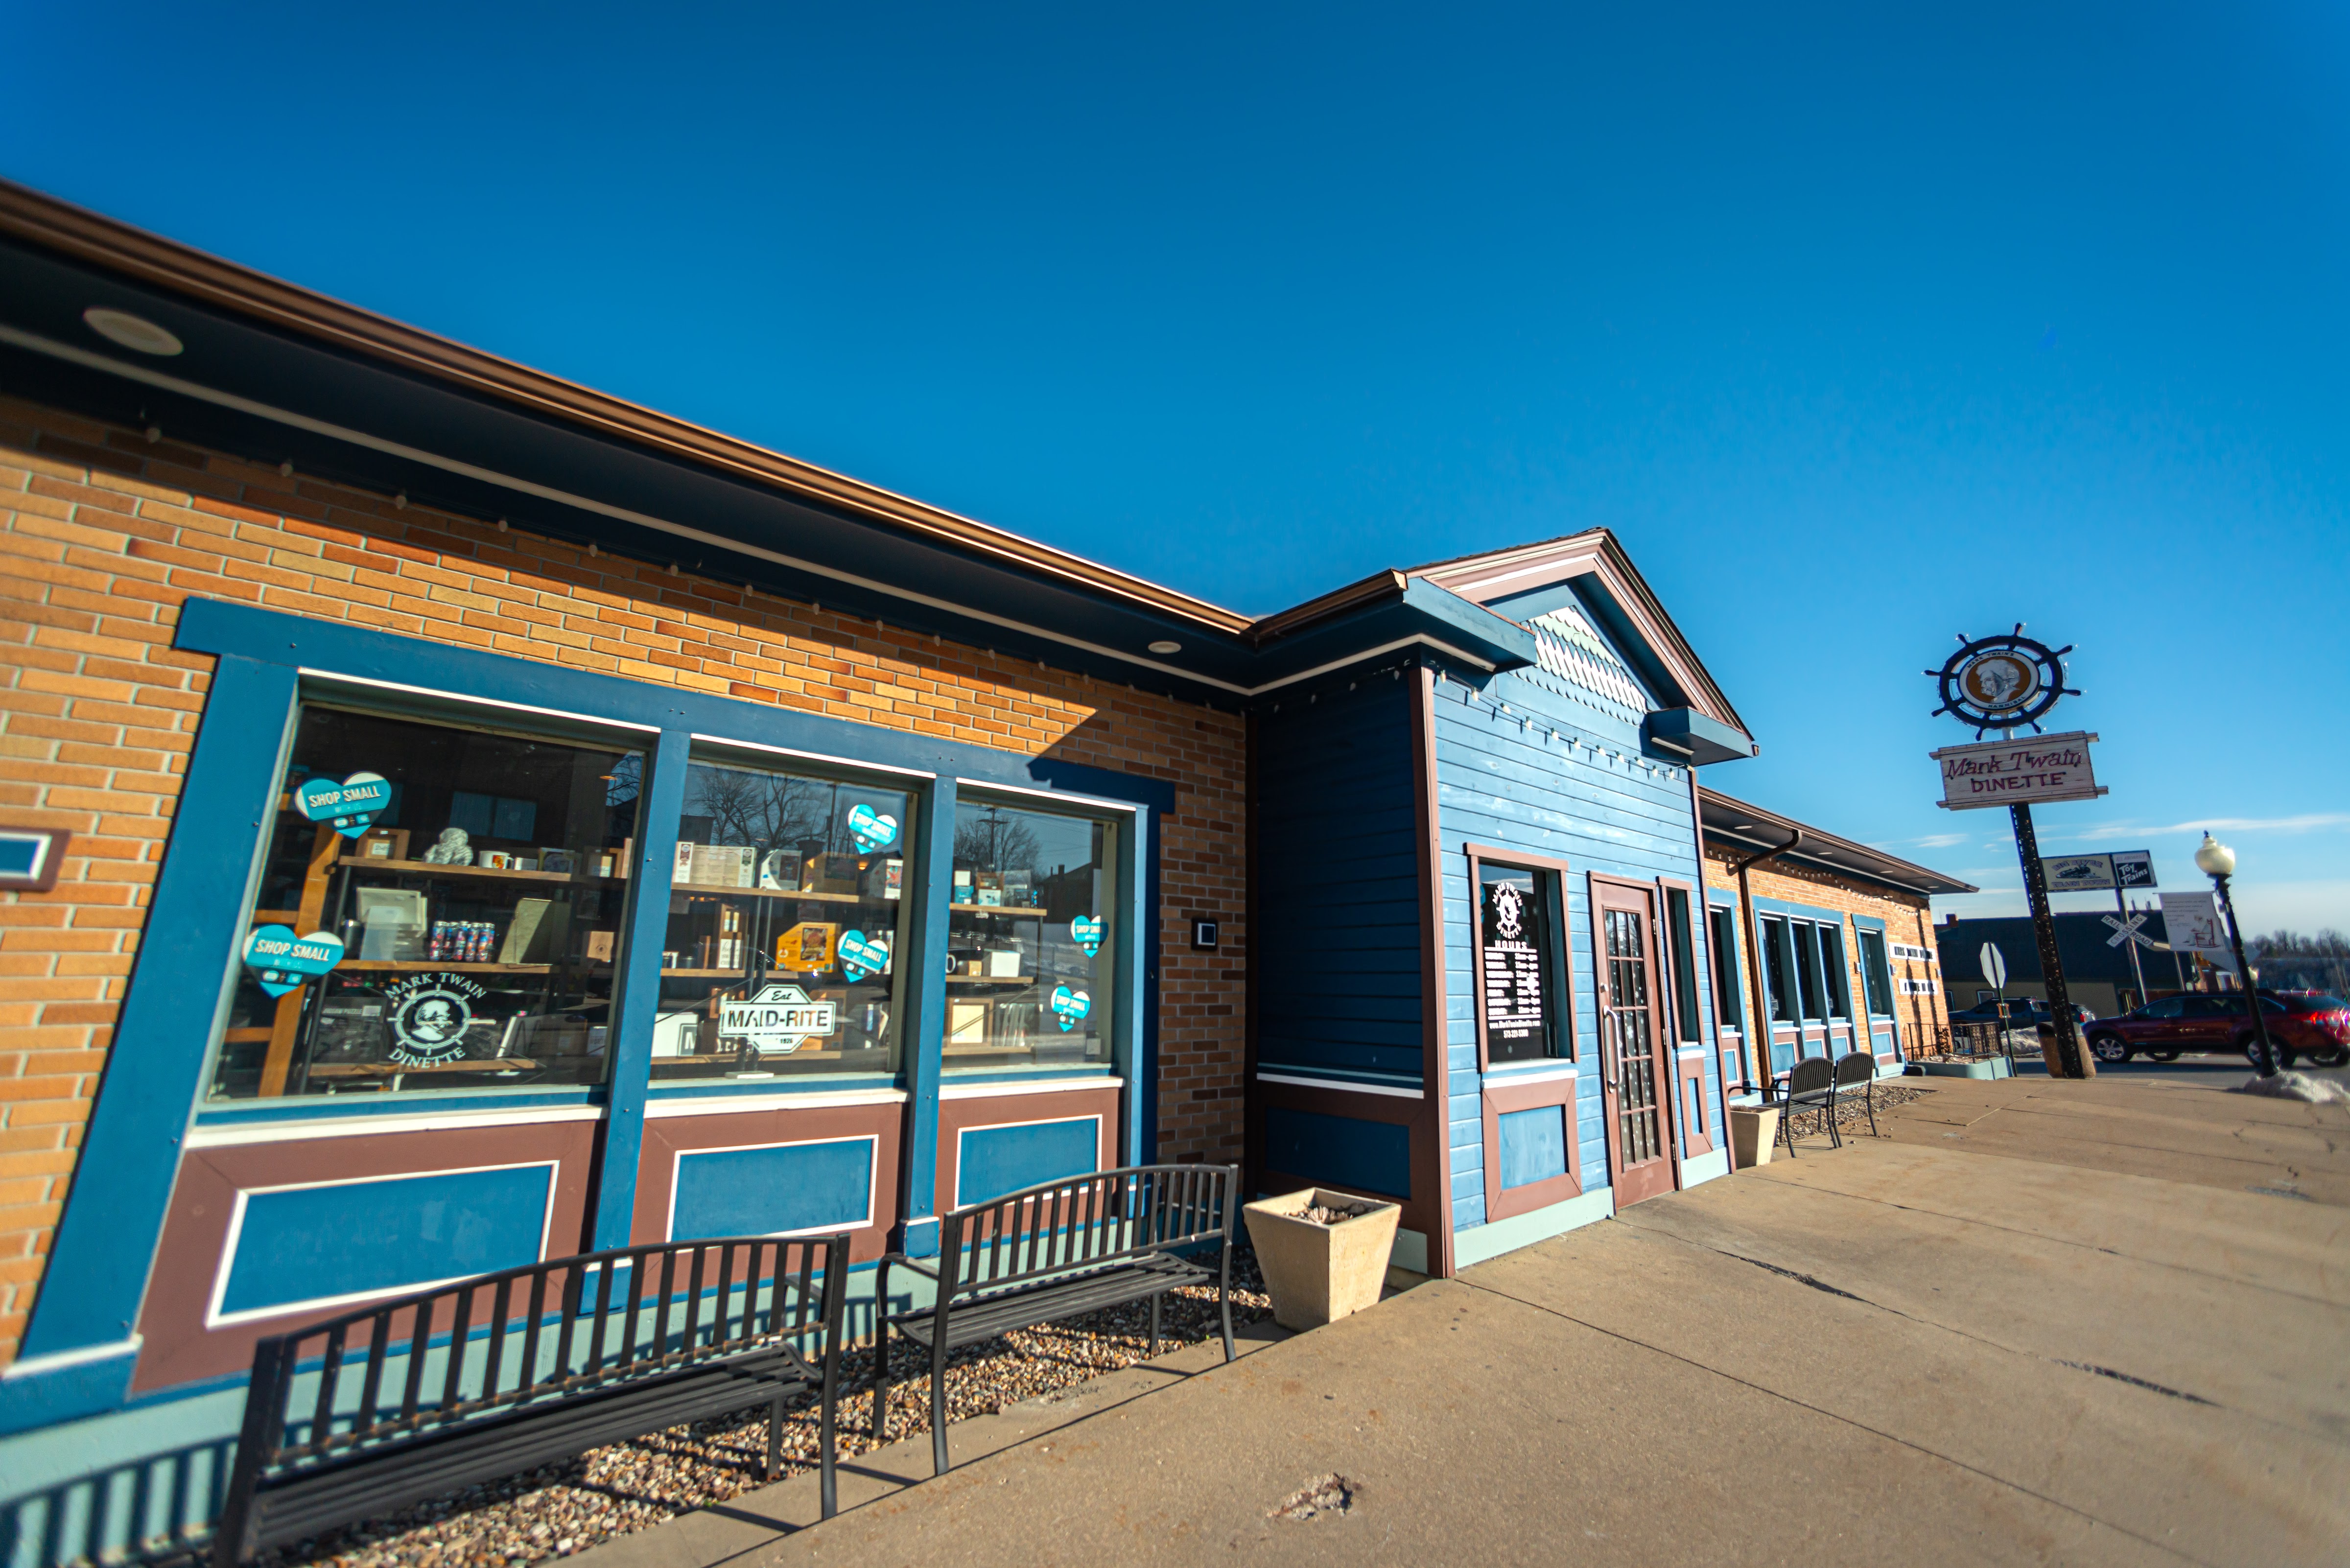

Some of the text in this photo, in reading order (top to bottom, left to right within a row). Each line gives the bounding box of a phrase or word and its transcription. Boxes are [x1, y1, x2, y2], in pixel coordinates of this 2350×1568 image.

[1967, 656, 1983, 668] MARK
[1988, 696, 2026, 708] HANNIBAL
[1945, 749, 2081, 776] Mark Twain
[1971, 772, 2066, 793] DINETTE
[308, 785, 381, 808] SHOP SMALL
[854, 812, 873, 827] SHOP
[870, 820, 892, 838] SMALL
[2052, 859, 2103, 870] BIG RIVER
[2119, 863, 2135, 875] Toy
[2121, 868, 2148, 885] Trains
[1492, 882, 1523, 907] MARK TWAIN
[1496, 921, 1523, 939] DINETTE
[2103, 916, 2150, 944] RAIL ROAD
[2110, 916, 2143, 944] CROSSING
[255, 939, 330, 962] SHOP SMALL
[844, 938, 863, 954] SHOP
[862, 946, 882, 963] SMALL
[1495, 940, 1527, 949] HOURS
[385, 972, 487, 999] MARK TWAIN
[771, 990, 792, 1001] Eat
[1069, 999, 1085, 1011] SMALL
[728, 1010, 829, 1028] MAID-RITE
[388, 1047, 466, 1069] DINETTE
